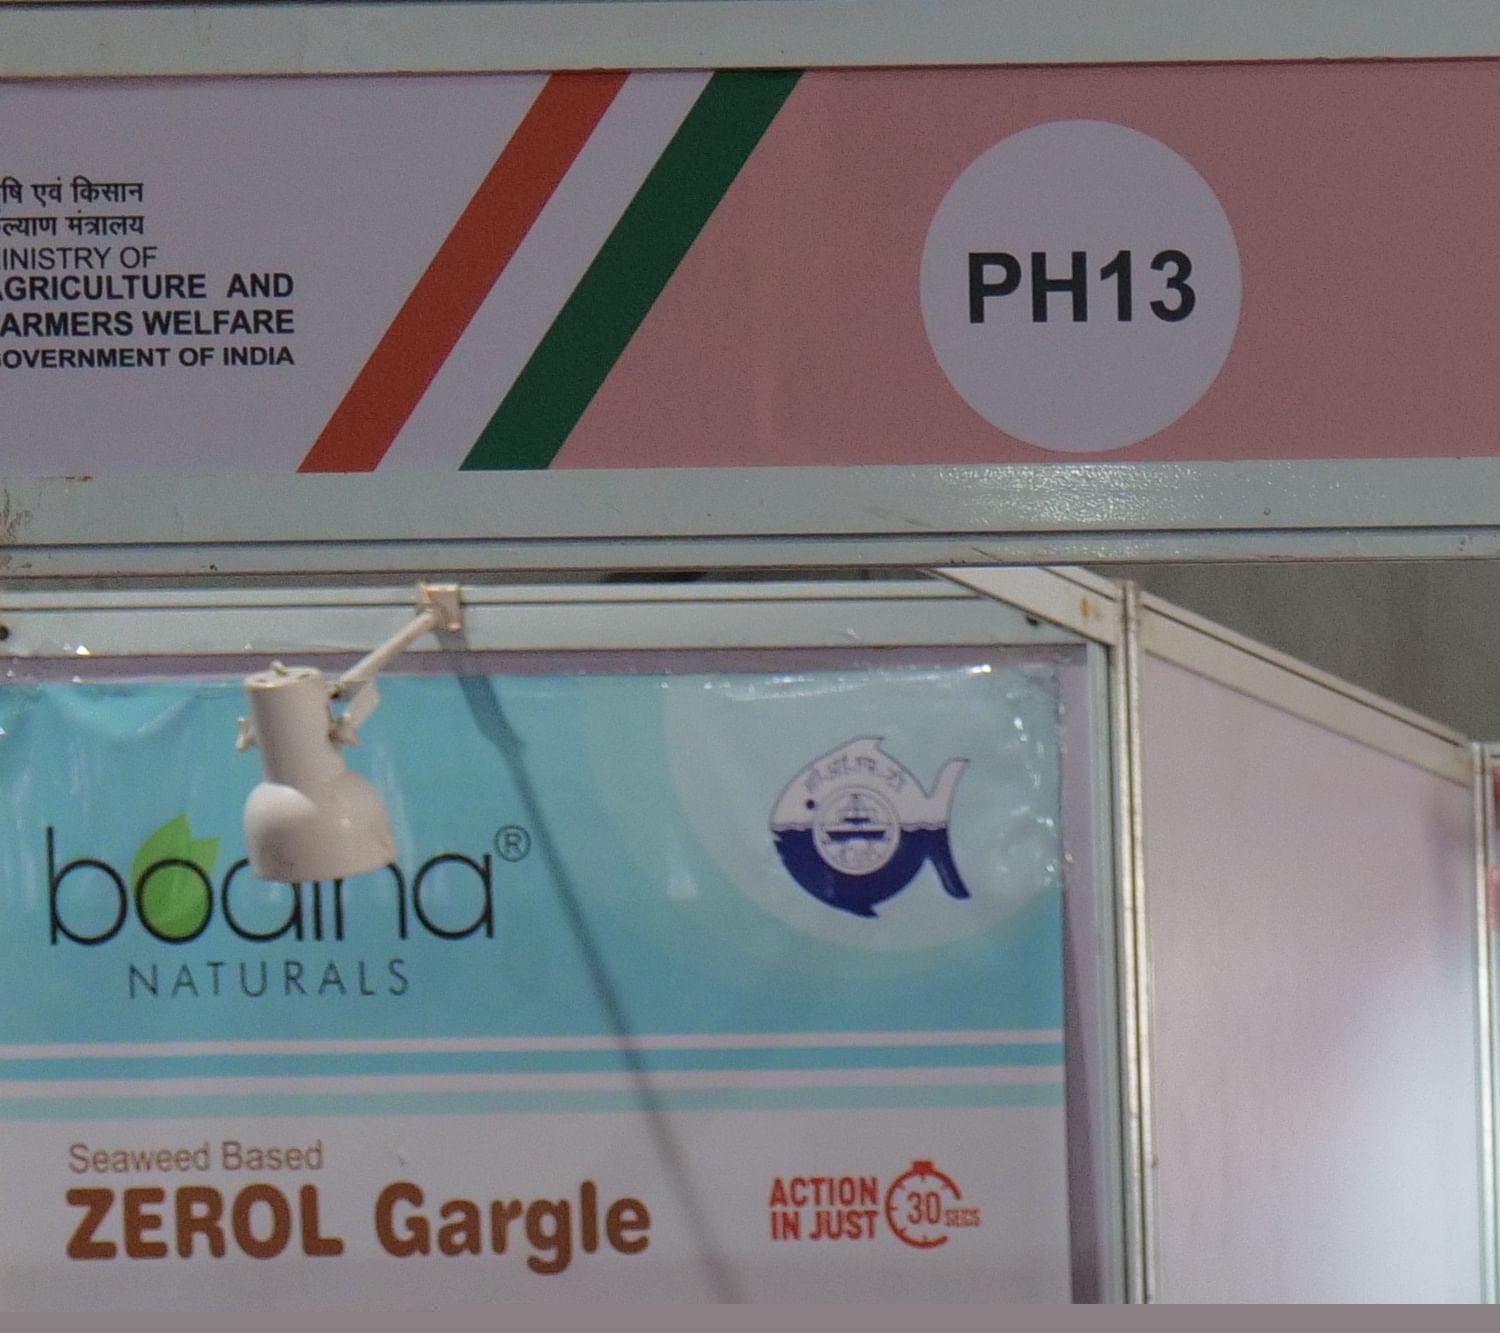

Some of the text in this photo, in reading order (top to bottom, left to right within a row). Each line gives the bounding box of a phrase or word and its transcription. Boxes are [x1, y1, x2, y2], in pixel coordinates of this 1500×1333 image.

[31, 175, 144, 207] एवं किसान
[65, 210, 144, 235] मंत्रालय
[120, 246, 157, 269] OF
[226, 273, 294, 298] AND
[968, 249, 1196, 324] PH13
[142, 309, 294, 335] WELFARE
[0, 346, 295, 369] OVERNMENT OF INDIA
[128, 959, 410, 999] NATURALS
[69, 1141, 323, 1174] Seaweed Based
[769, 1177, 878, 1206] ACTION
[906, 1191, 942, 1224] 30
[66, 1180, 651, 1276] ZEROL Gargle
[771, 1209, 878, 1240] IN JUST
